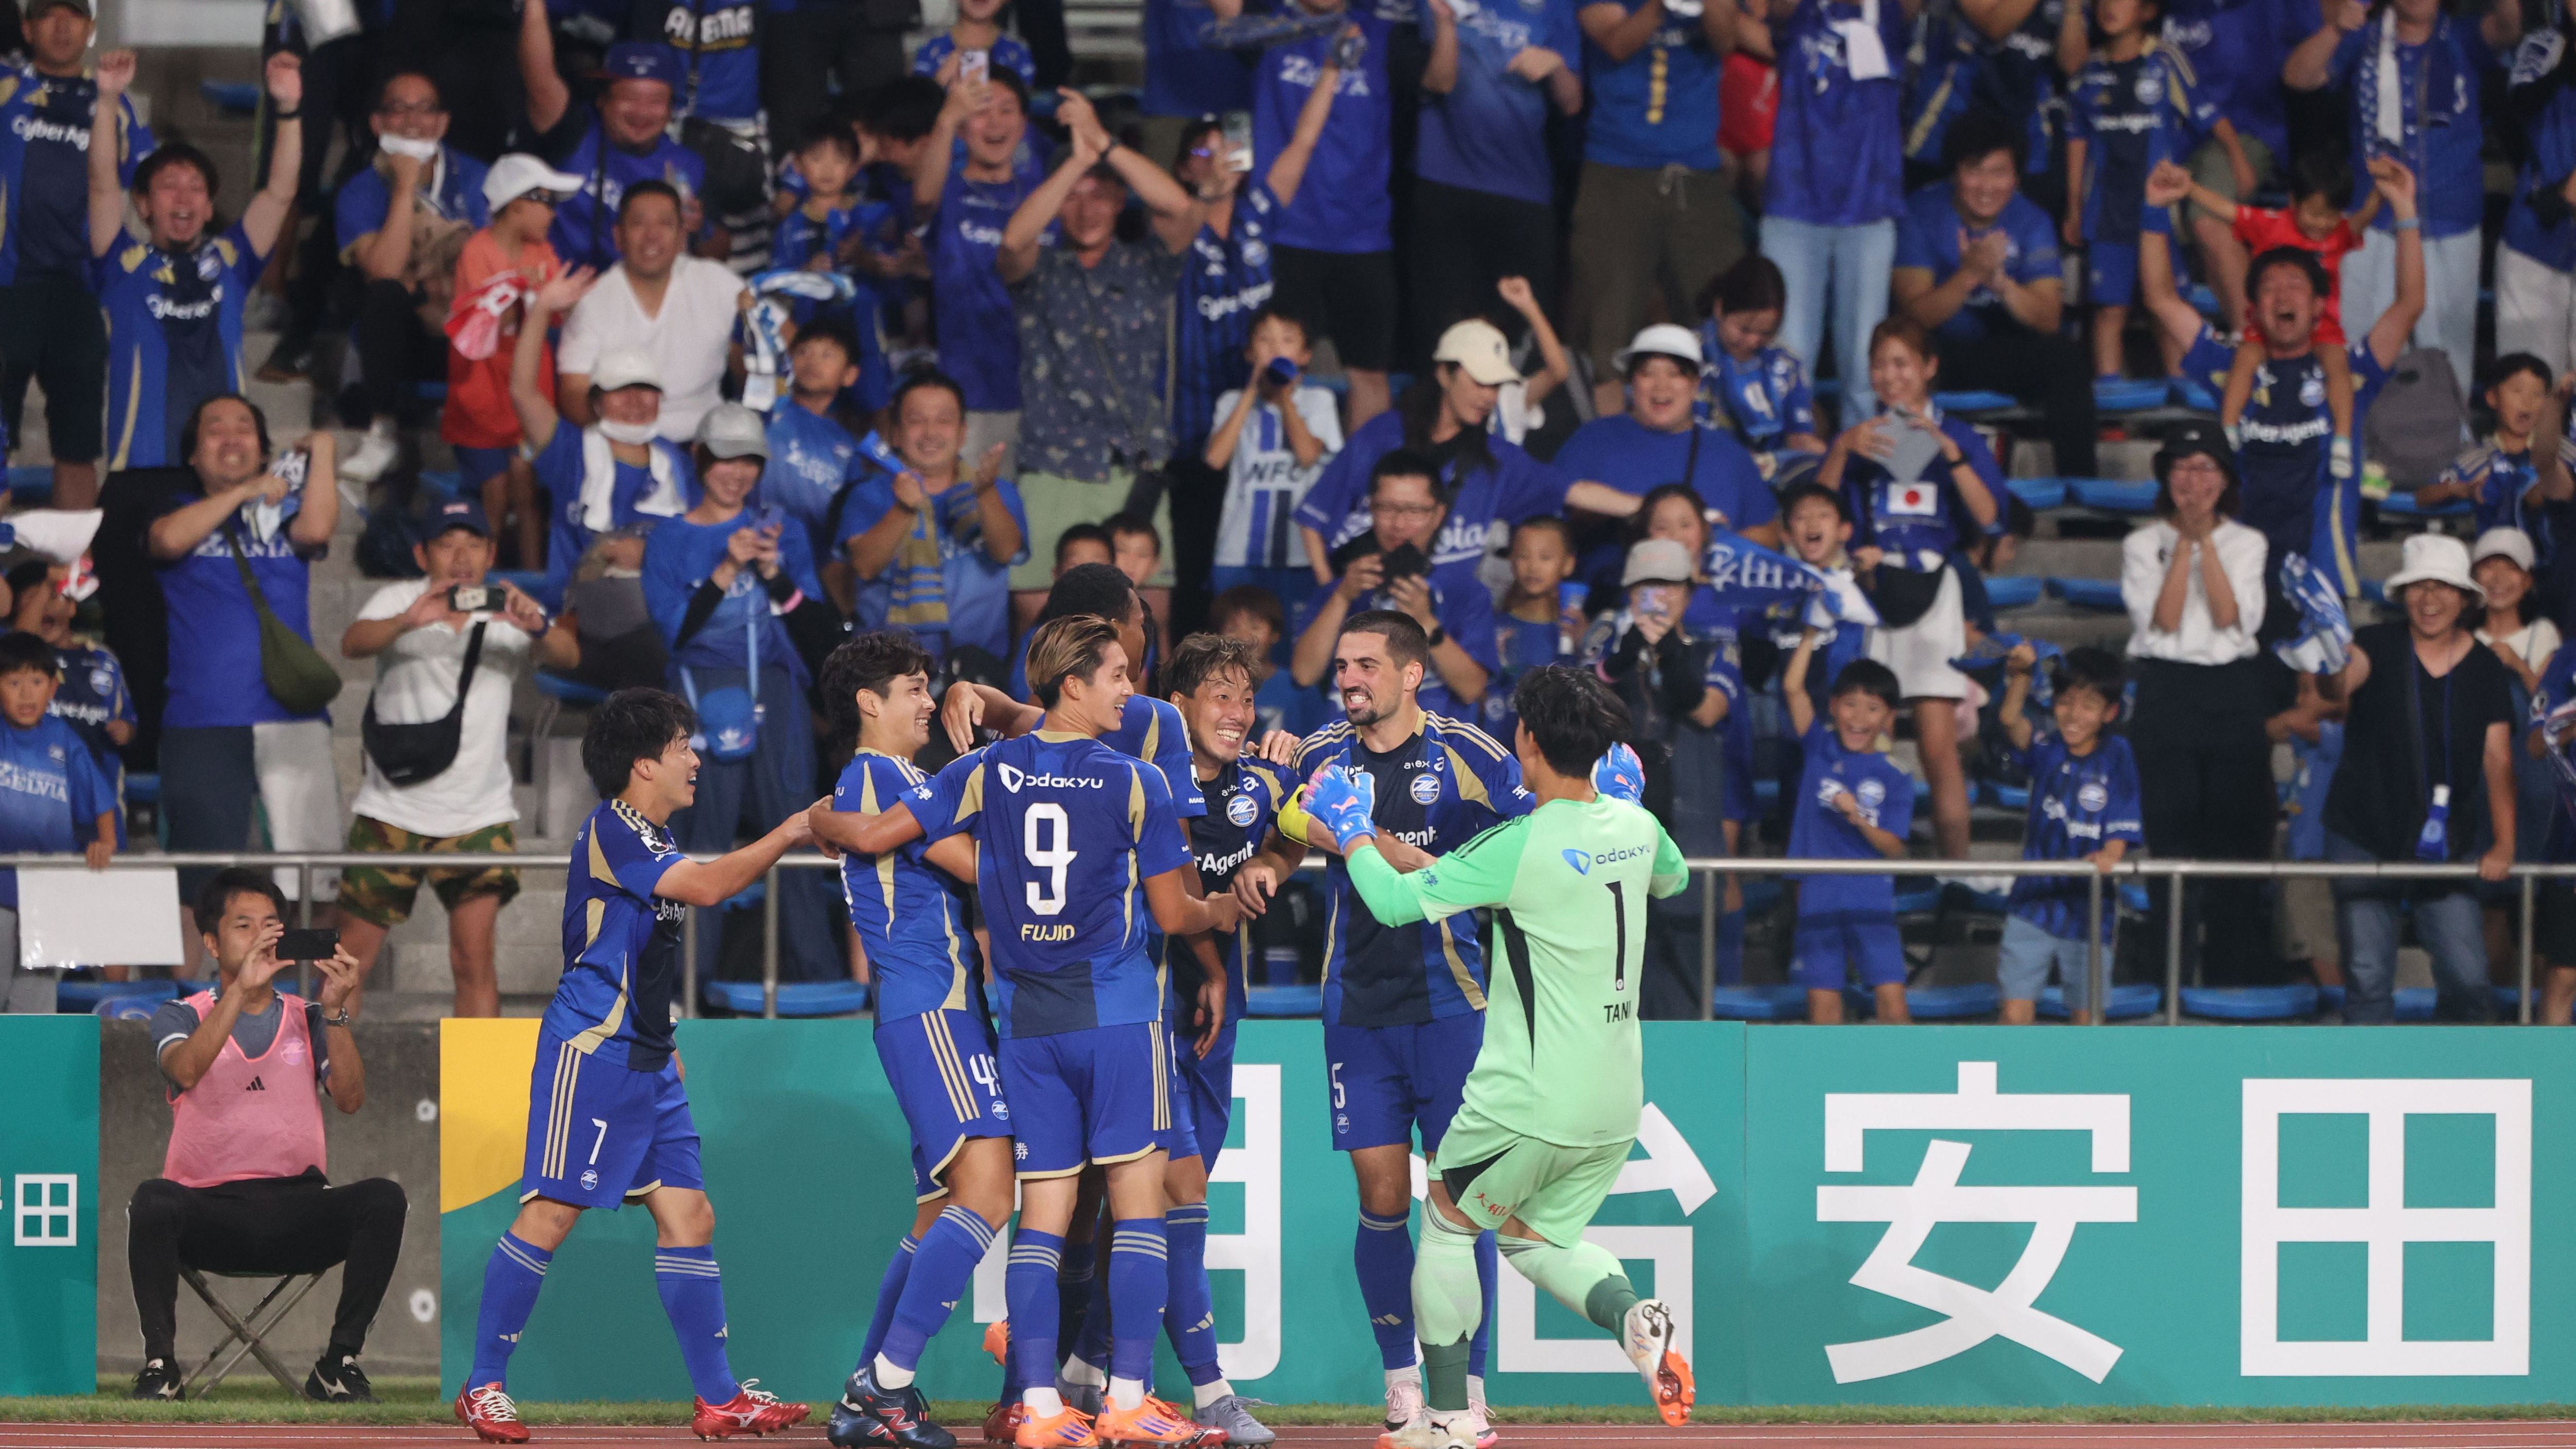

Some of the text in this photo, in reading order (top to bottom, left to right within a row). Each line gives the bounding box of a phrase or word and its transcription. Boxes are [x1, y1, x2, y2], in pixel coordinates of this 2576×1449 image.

[1025, 772, 1104, 789] odakyu
[1024, 803, 1077, 915] 9
[1387, 826, 1434, 847] gent
[1021, 923, 1076, 942] FUJIO
[1605, 881, 1626, 991] 1
[1604, 1000, 1632, 1023] TANI
[1331, 1062, 1346, 1109] 5
[591, 1118, 608, 1165] 7
[0, 1174, 78, 1247] 田
